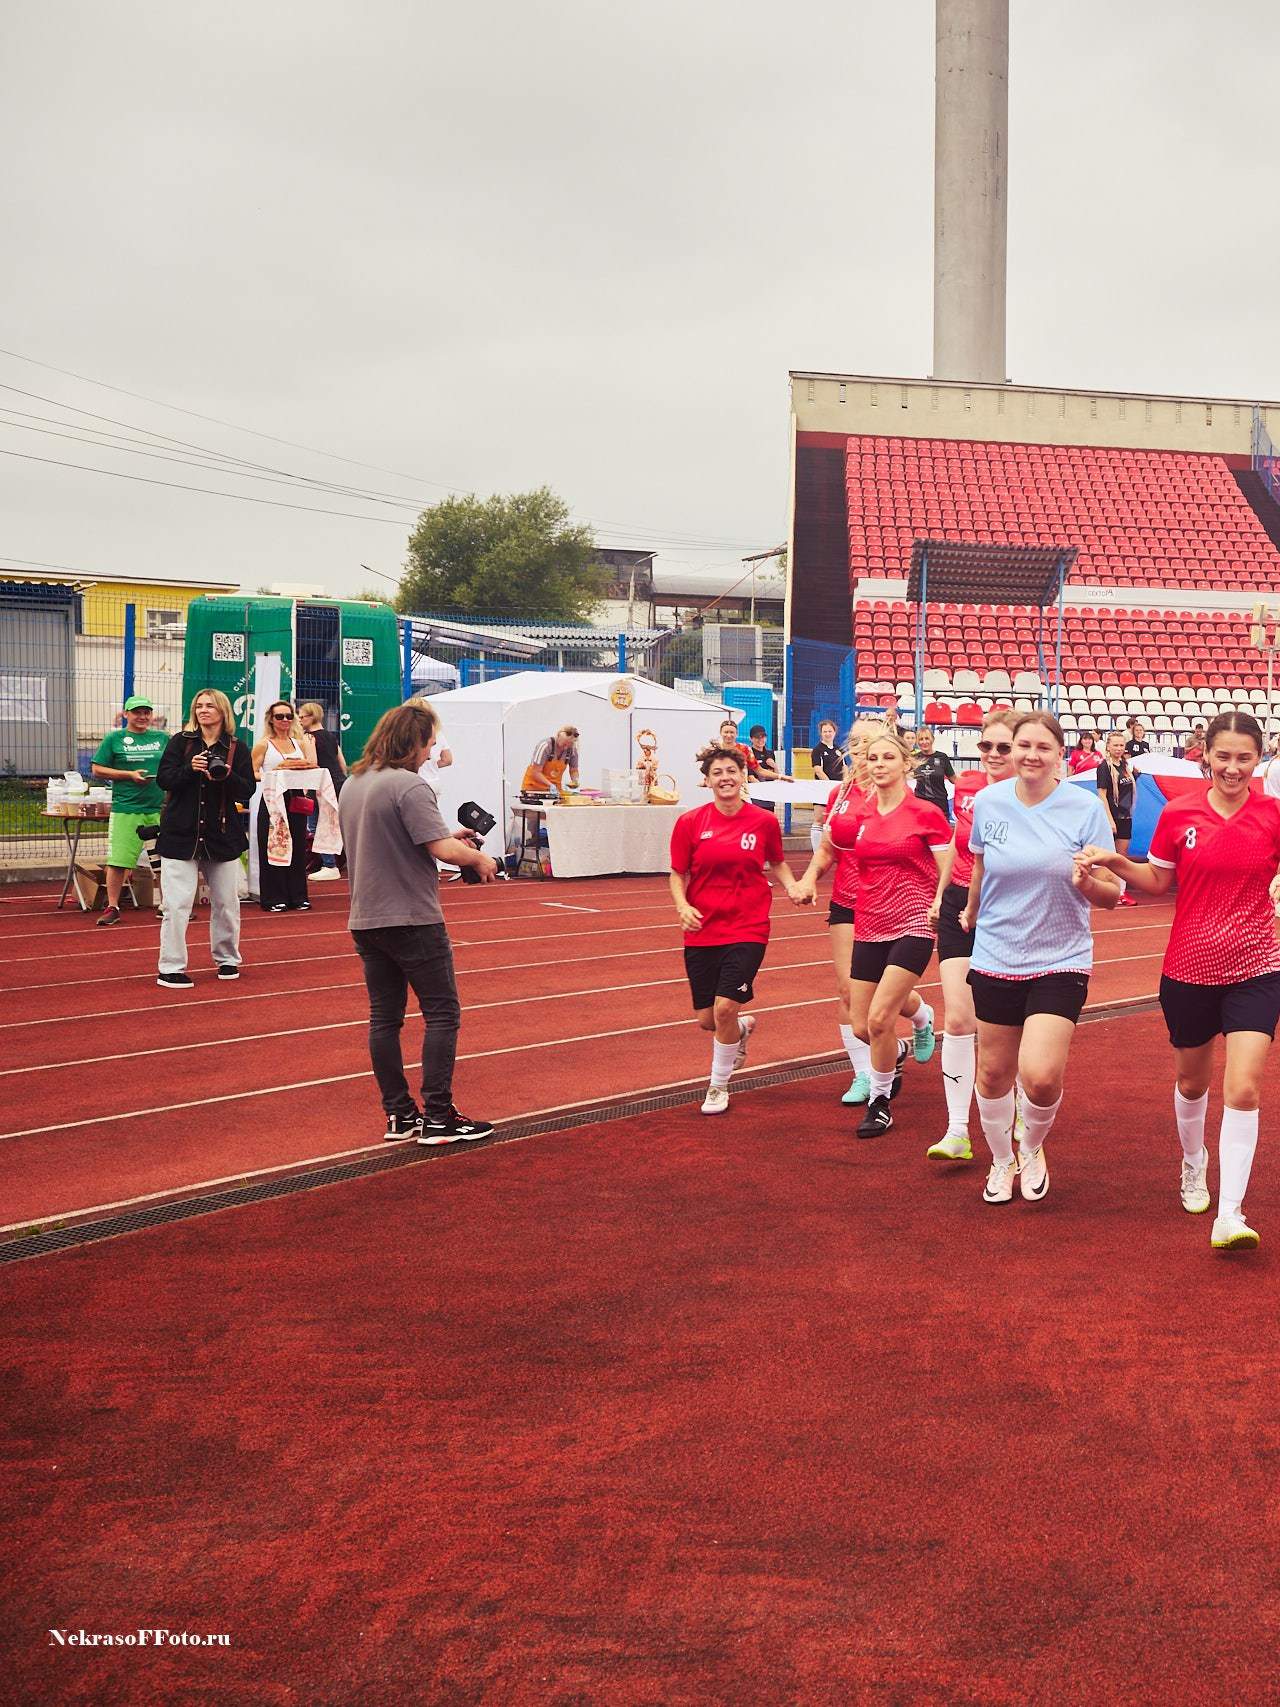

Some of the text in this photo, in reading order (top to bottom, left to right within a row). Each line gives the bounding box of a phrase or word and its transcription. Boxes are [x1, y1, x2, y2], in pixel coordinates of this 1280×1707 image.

[740, 832, 757, 851] 69
[984, 820, 1009, 845] 24
[1185, 826, 1197, 849] 8
